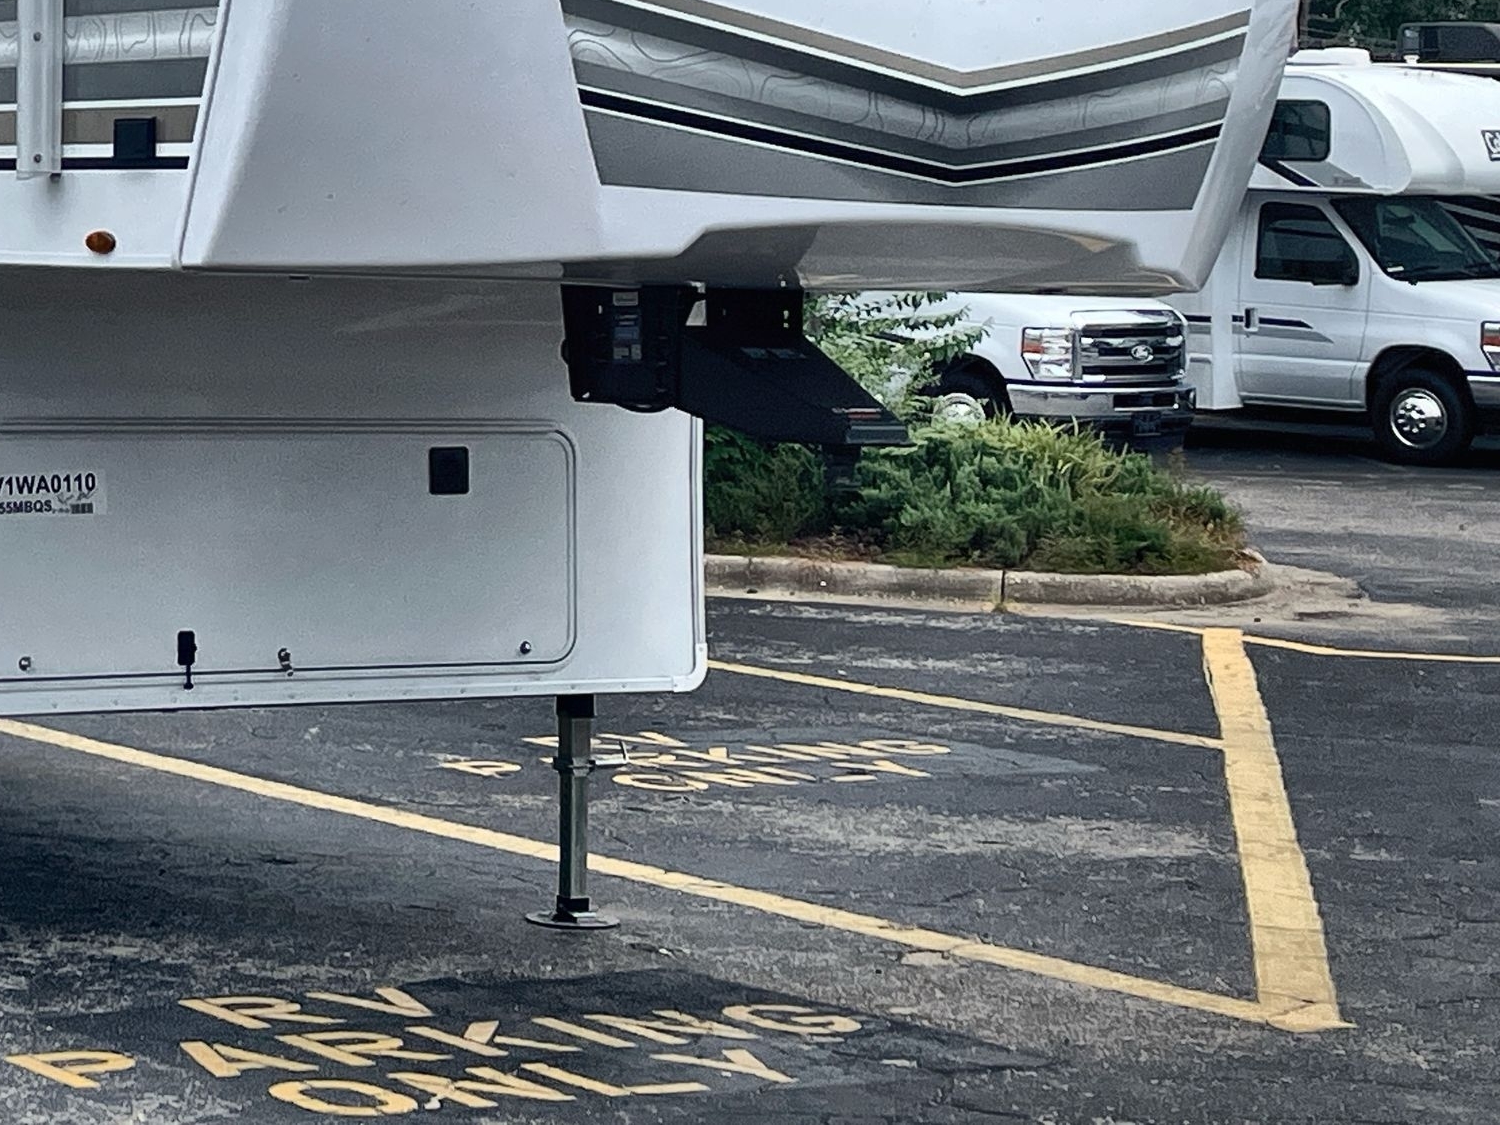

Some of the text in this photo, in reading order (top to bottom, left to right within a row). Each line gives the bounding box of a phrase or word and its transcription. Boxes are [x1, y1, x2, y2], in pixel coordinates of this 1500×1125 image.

[439, 739, 952, 779] PRKING
[612, 759, 932, 792] ONLY
[177, 986, 435, 1030] RV
[5, 1003, 863, 1089] PARKING
[268, 1048, 799, 1117] ONLY
